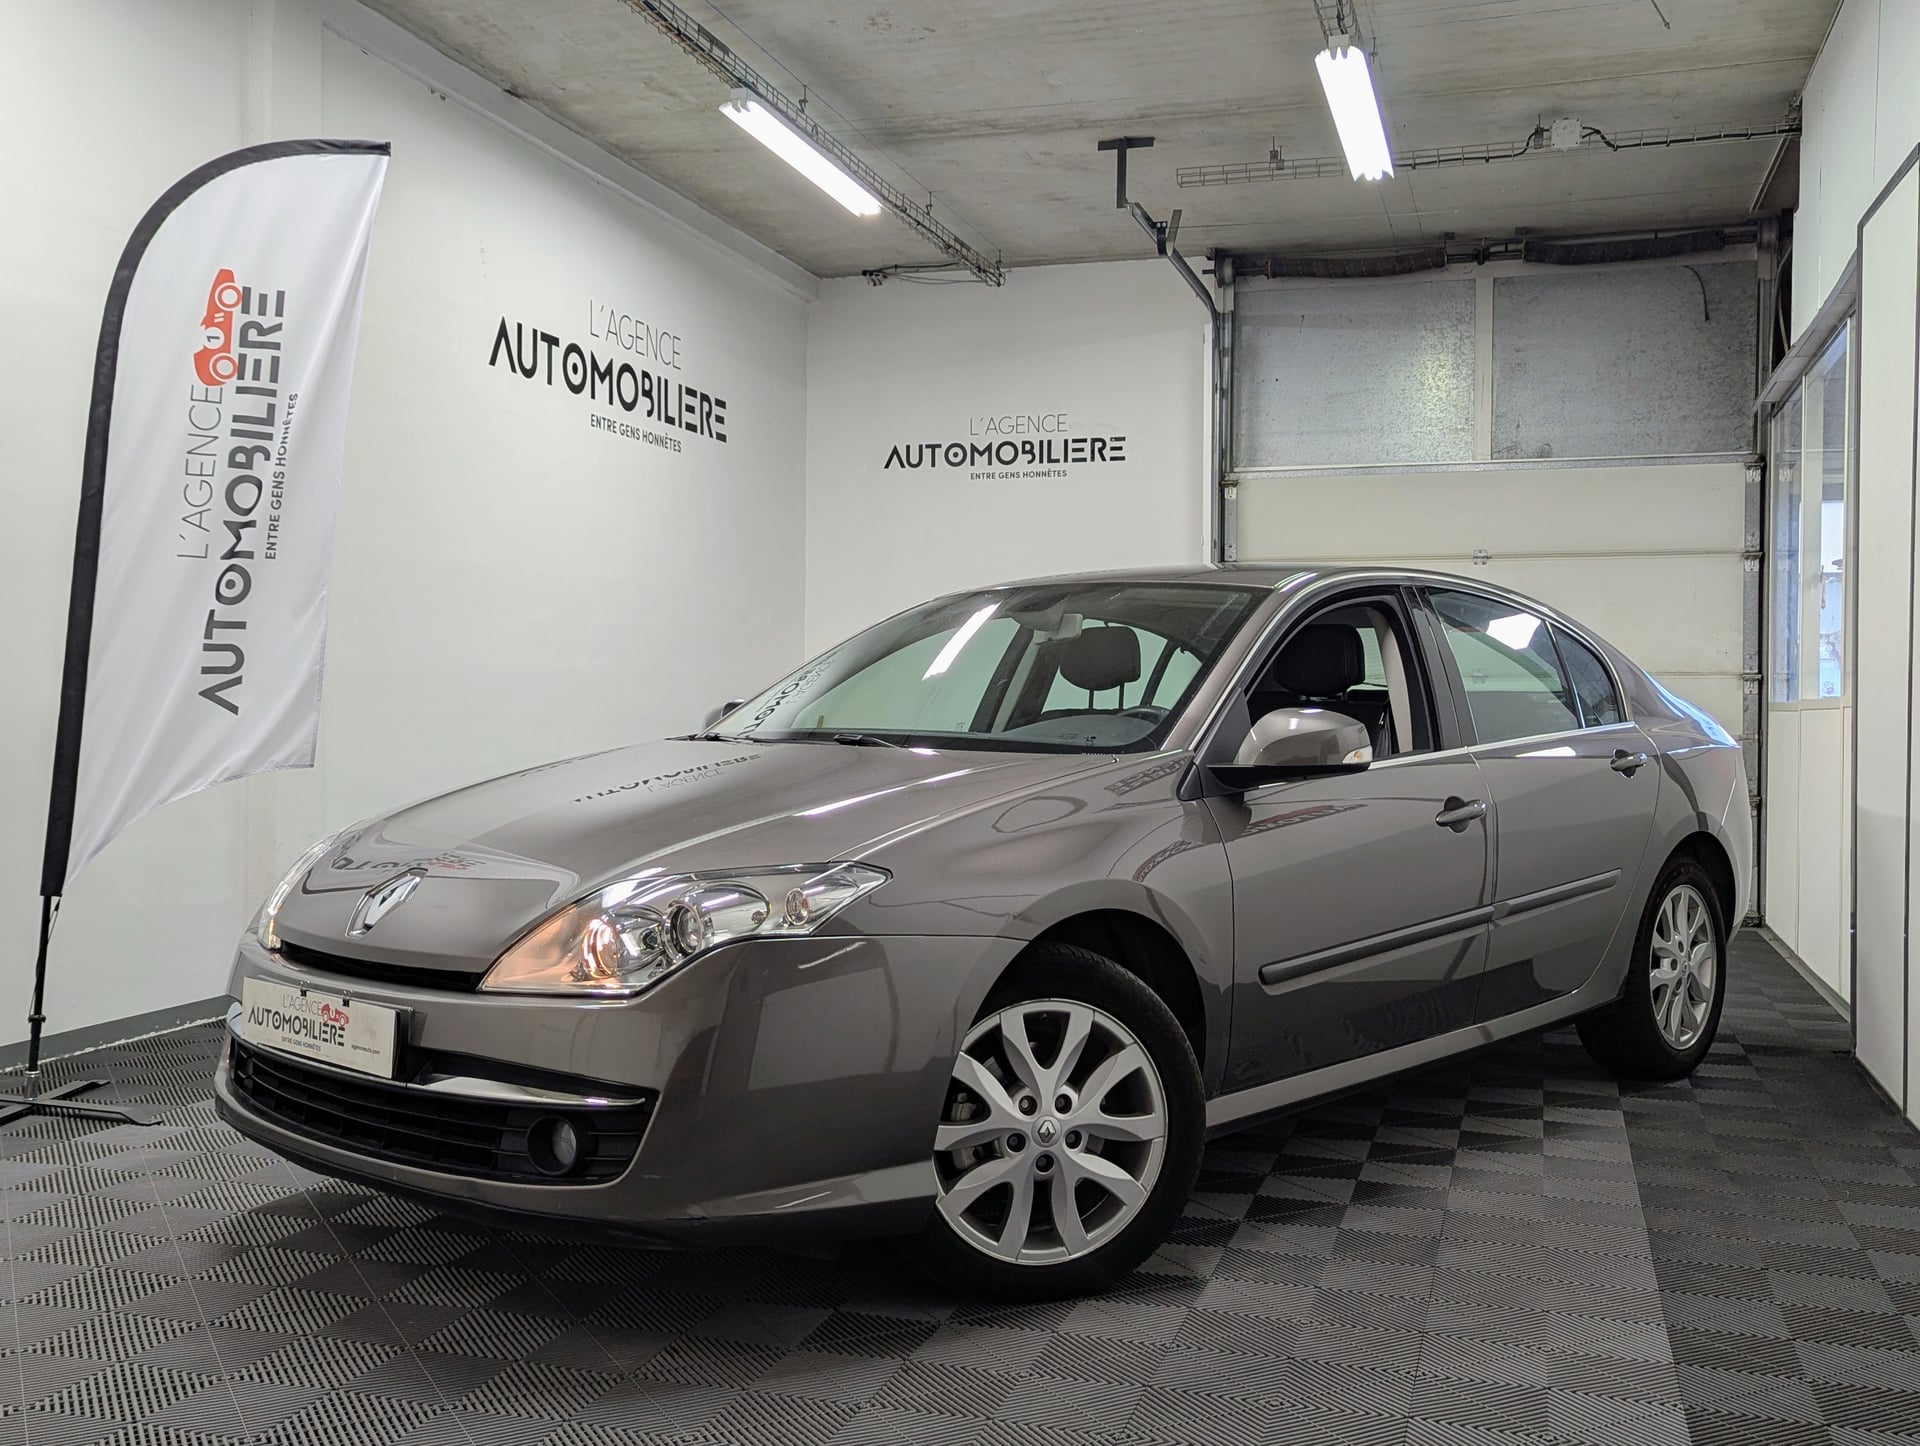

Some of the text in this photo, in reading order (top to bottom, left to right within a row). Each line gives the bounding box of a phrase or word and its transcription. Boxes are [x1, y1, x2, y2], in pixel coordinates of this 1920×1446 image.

[589, 299, 682, 371] L'AGENCE
[488, 315, 728, 444] AUTOMOBILIERE
[590, 413, 682, 453] ENTRE GENS HONNÊTES
[969, 413, 1069, 436] L'AGENCE
[177, 384, 223, 560] L'AGENCE
[883, 436, 1127, 470] AUTOMOBILIERE
[265, 392, 299, 560] ENTRE GENS HONNÊTES
[970, 470, 997, 481] ENTRE
[997, 470, 1021, 480] GENS
[198, 286, 286, 717] AUTOMOBILIERE
[248, 1005, 346, 1047] AUTOMOBILIERE
[282, 993, 323, 1017] L'AGENCE
